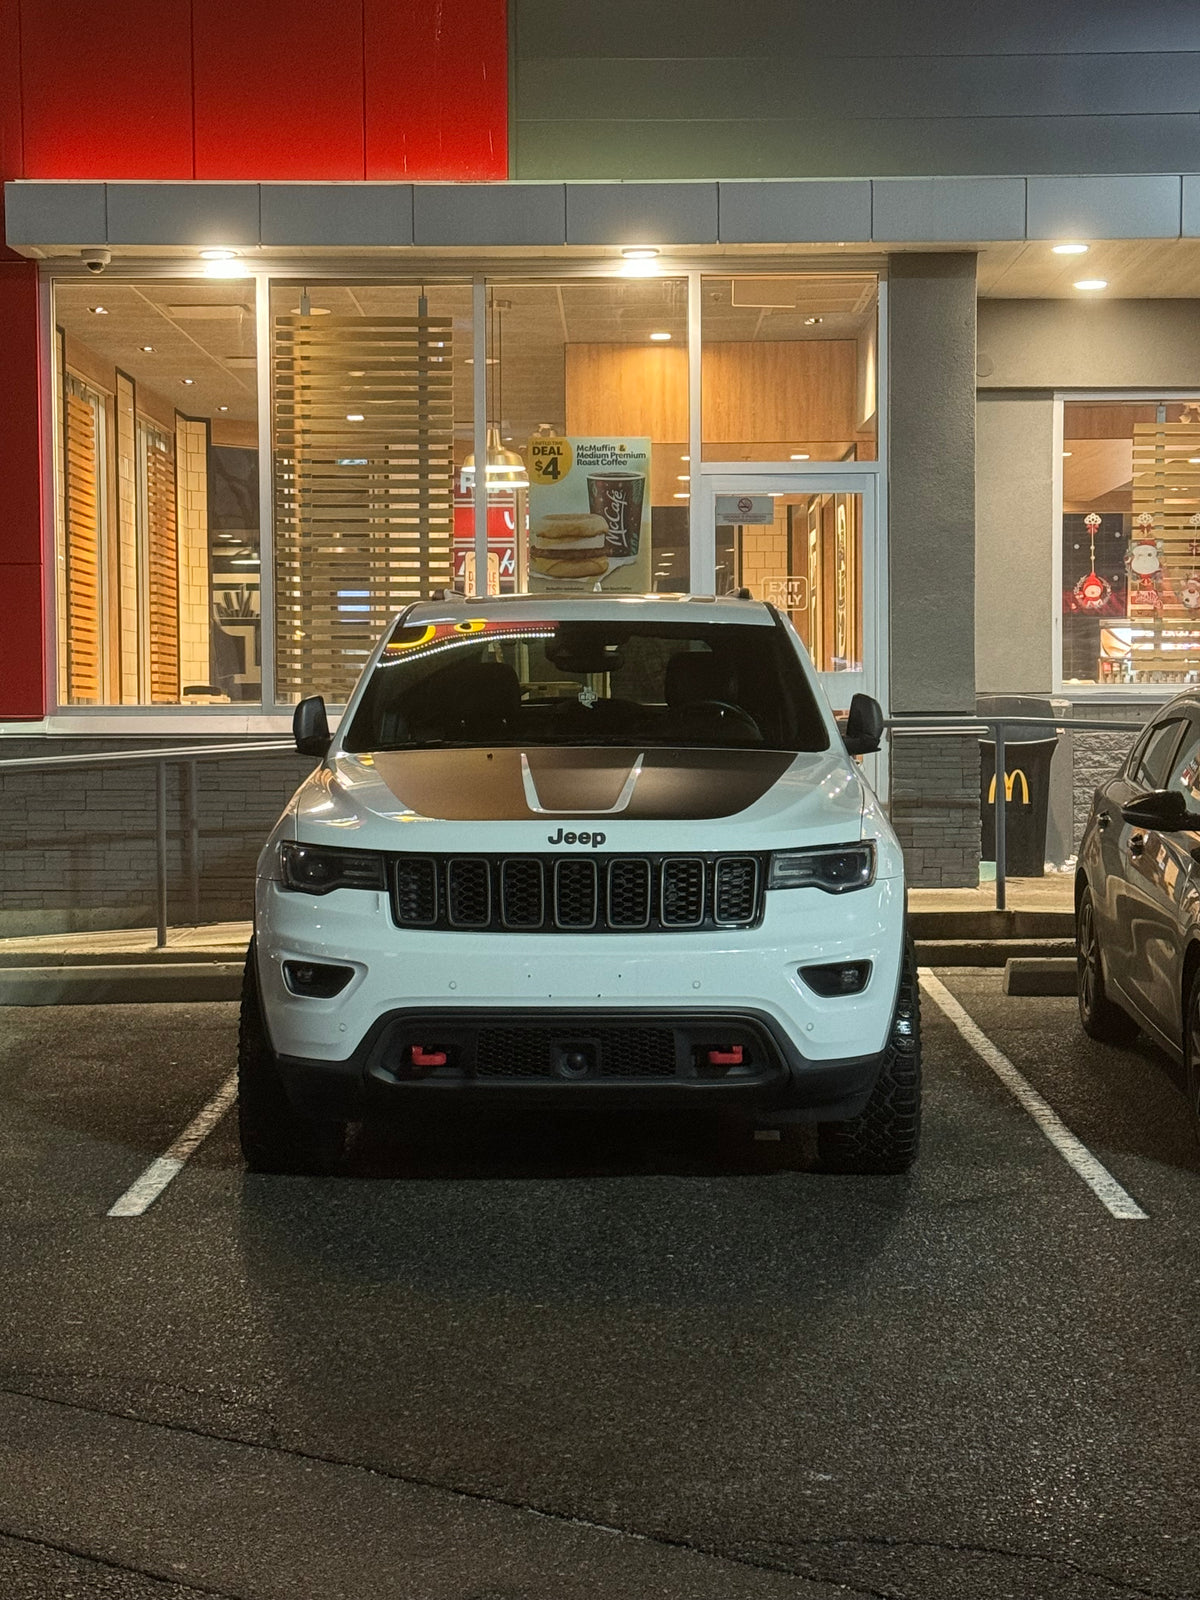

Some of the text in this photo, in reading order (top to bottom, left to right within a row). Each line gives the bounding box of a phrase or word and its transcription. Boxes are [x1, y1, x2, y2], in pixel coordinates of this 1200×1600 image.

[533, 446, 563, 455] DEAL
[576, 444, 626, 452] McMuffin &
[535, 457, 561, 480] $4
[769, 582, 800, 592] EXIT
[767, 595, 802, 605] ONLY
[548, 828, 606, 848] Jeep
